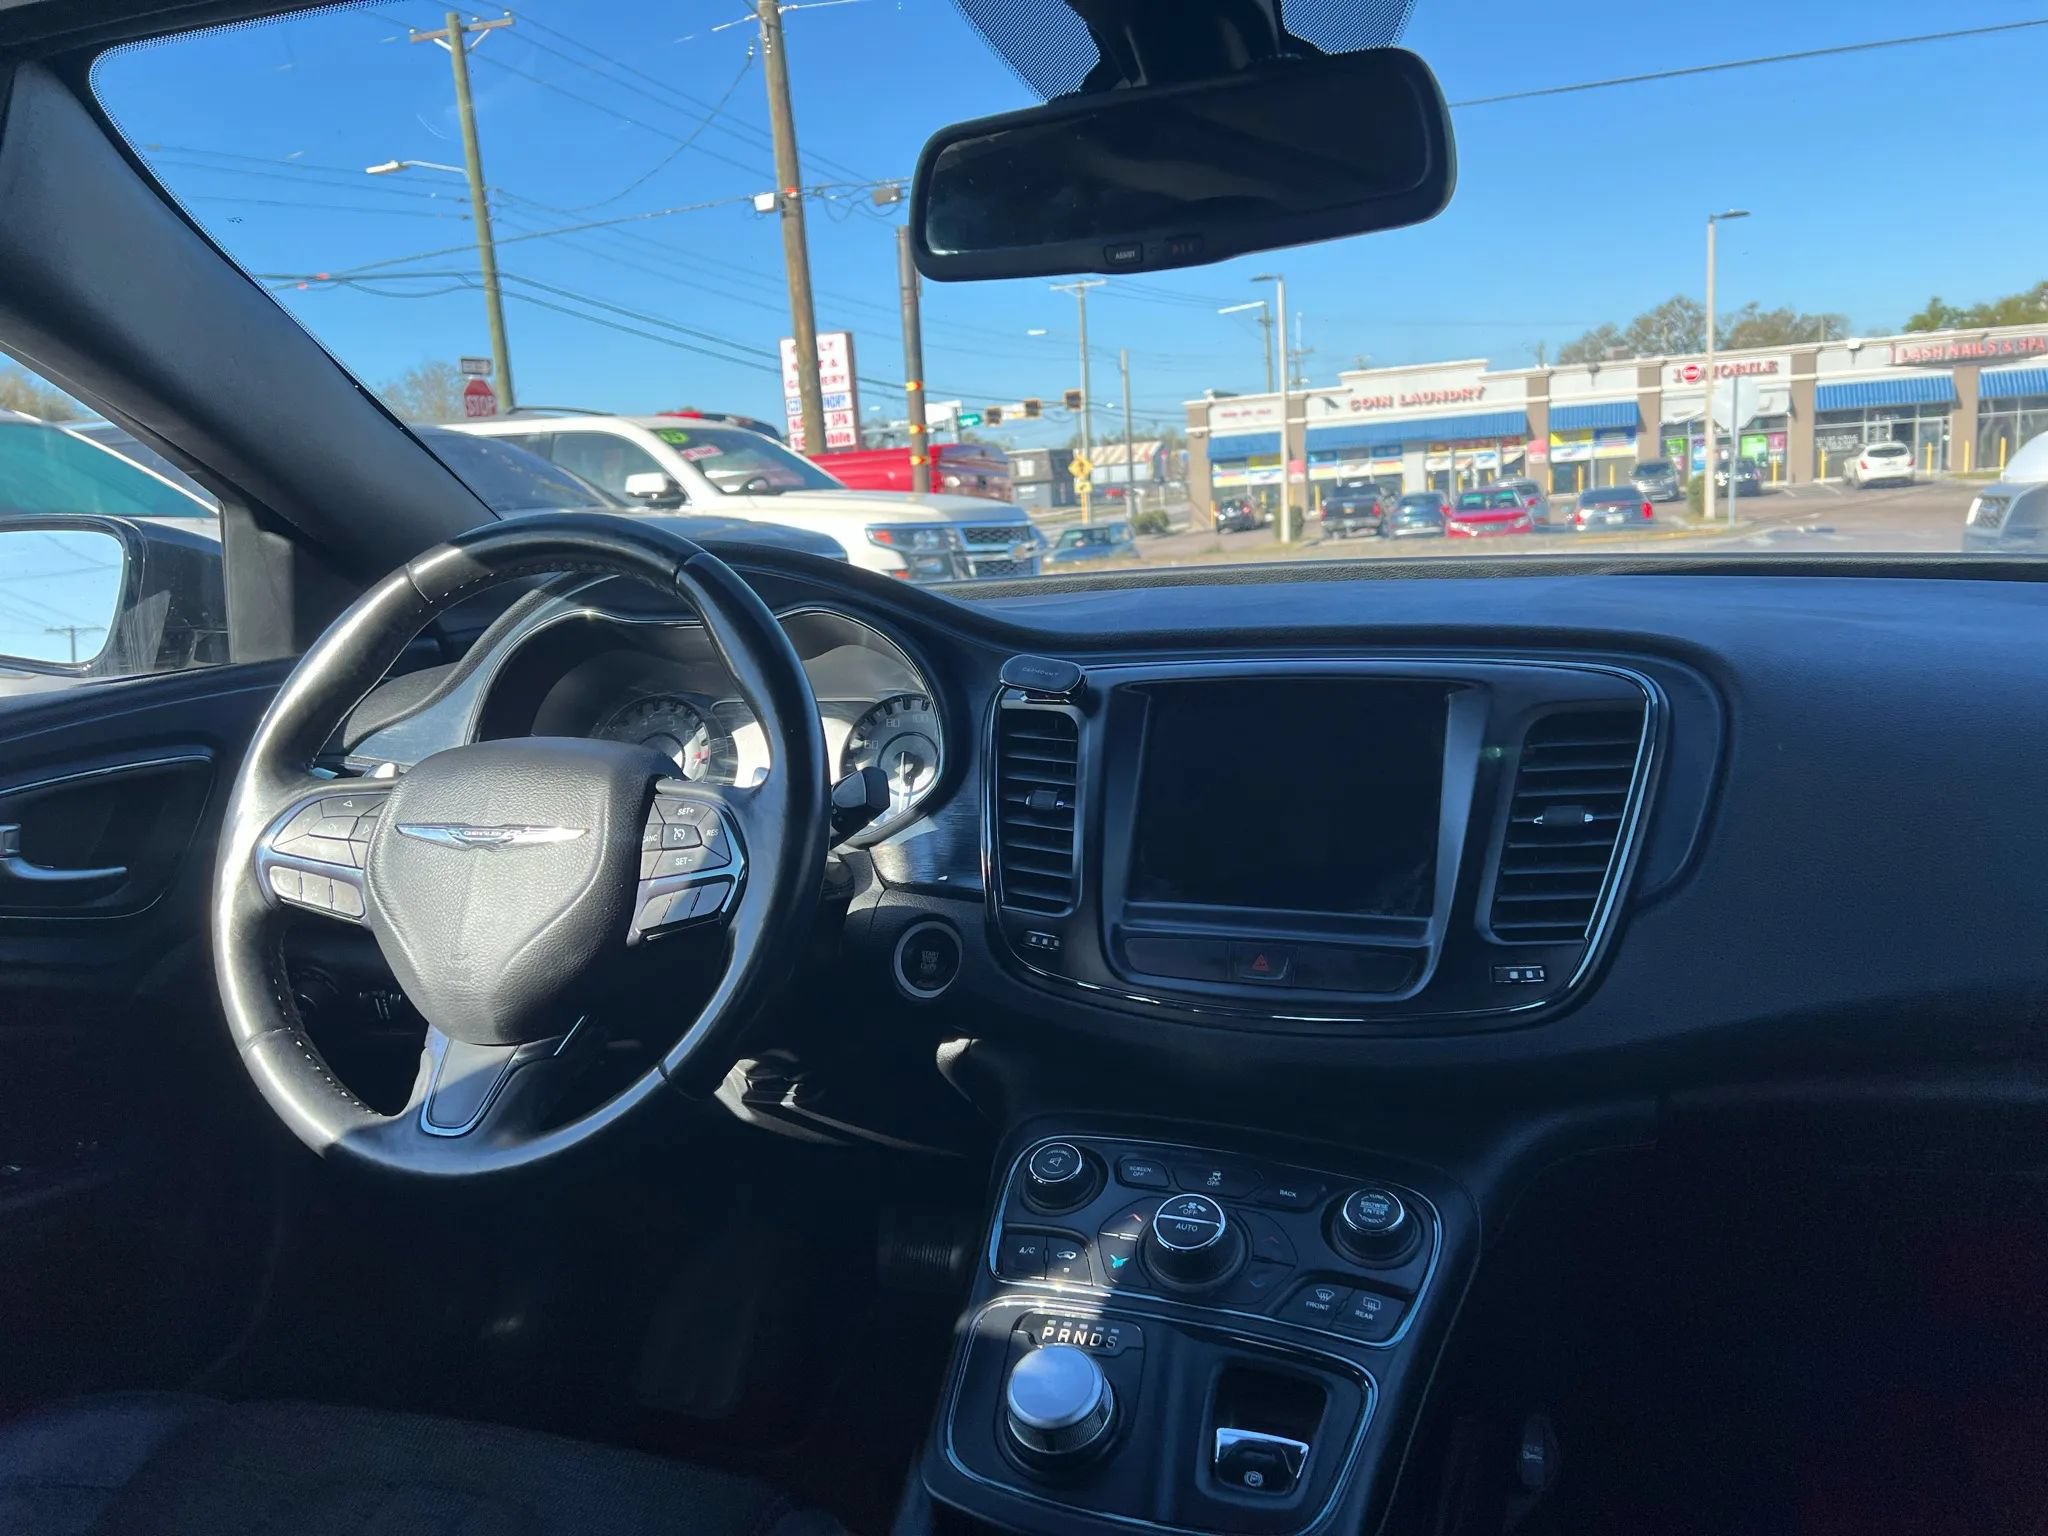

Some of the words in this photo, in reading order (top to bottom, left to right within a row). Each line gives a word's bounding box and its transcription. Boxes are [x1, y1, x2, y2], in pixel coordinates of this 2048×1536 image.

[1115, 250, 1136, 259] ASSIST
[1950, 339, 1998, 357] NAILS
[2018, 335, 2045, 350] SPA
[1350, 395, 1394, 412] COIN
[1399, 385, 1485, 407] LAUNDRY
[886, 719, 900, 727] 80
[864, 740, 878, 749] 60
[1280, 1190, 1297, 1198] BACK
[1360, 1201, 1389, 1210] BROWSE
[1183, 1208, 1199, 1216] OFF
[1176, 1224, 1199, 1232] AUTO
[1019, 1246, 1036, 1254] A/C
[1306, 1301, 1331, 1311] FRONT
[1355, 1310, 1374, 1320] REAR
